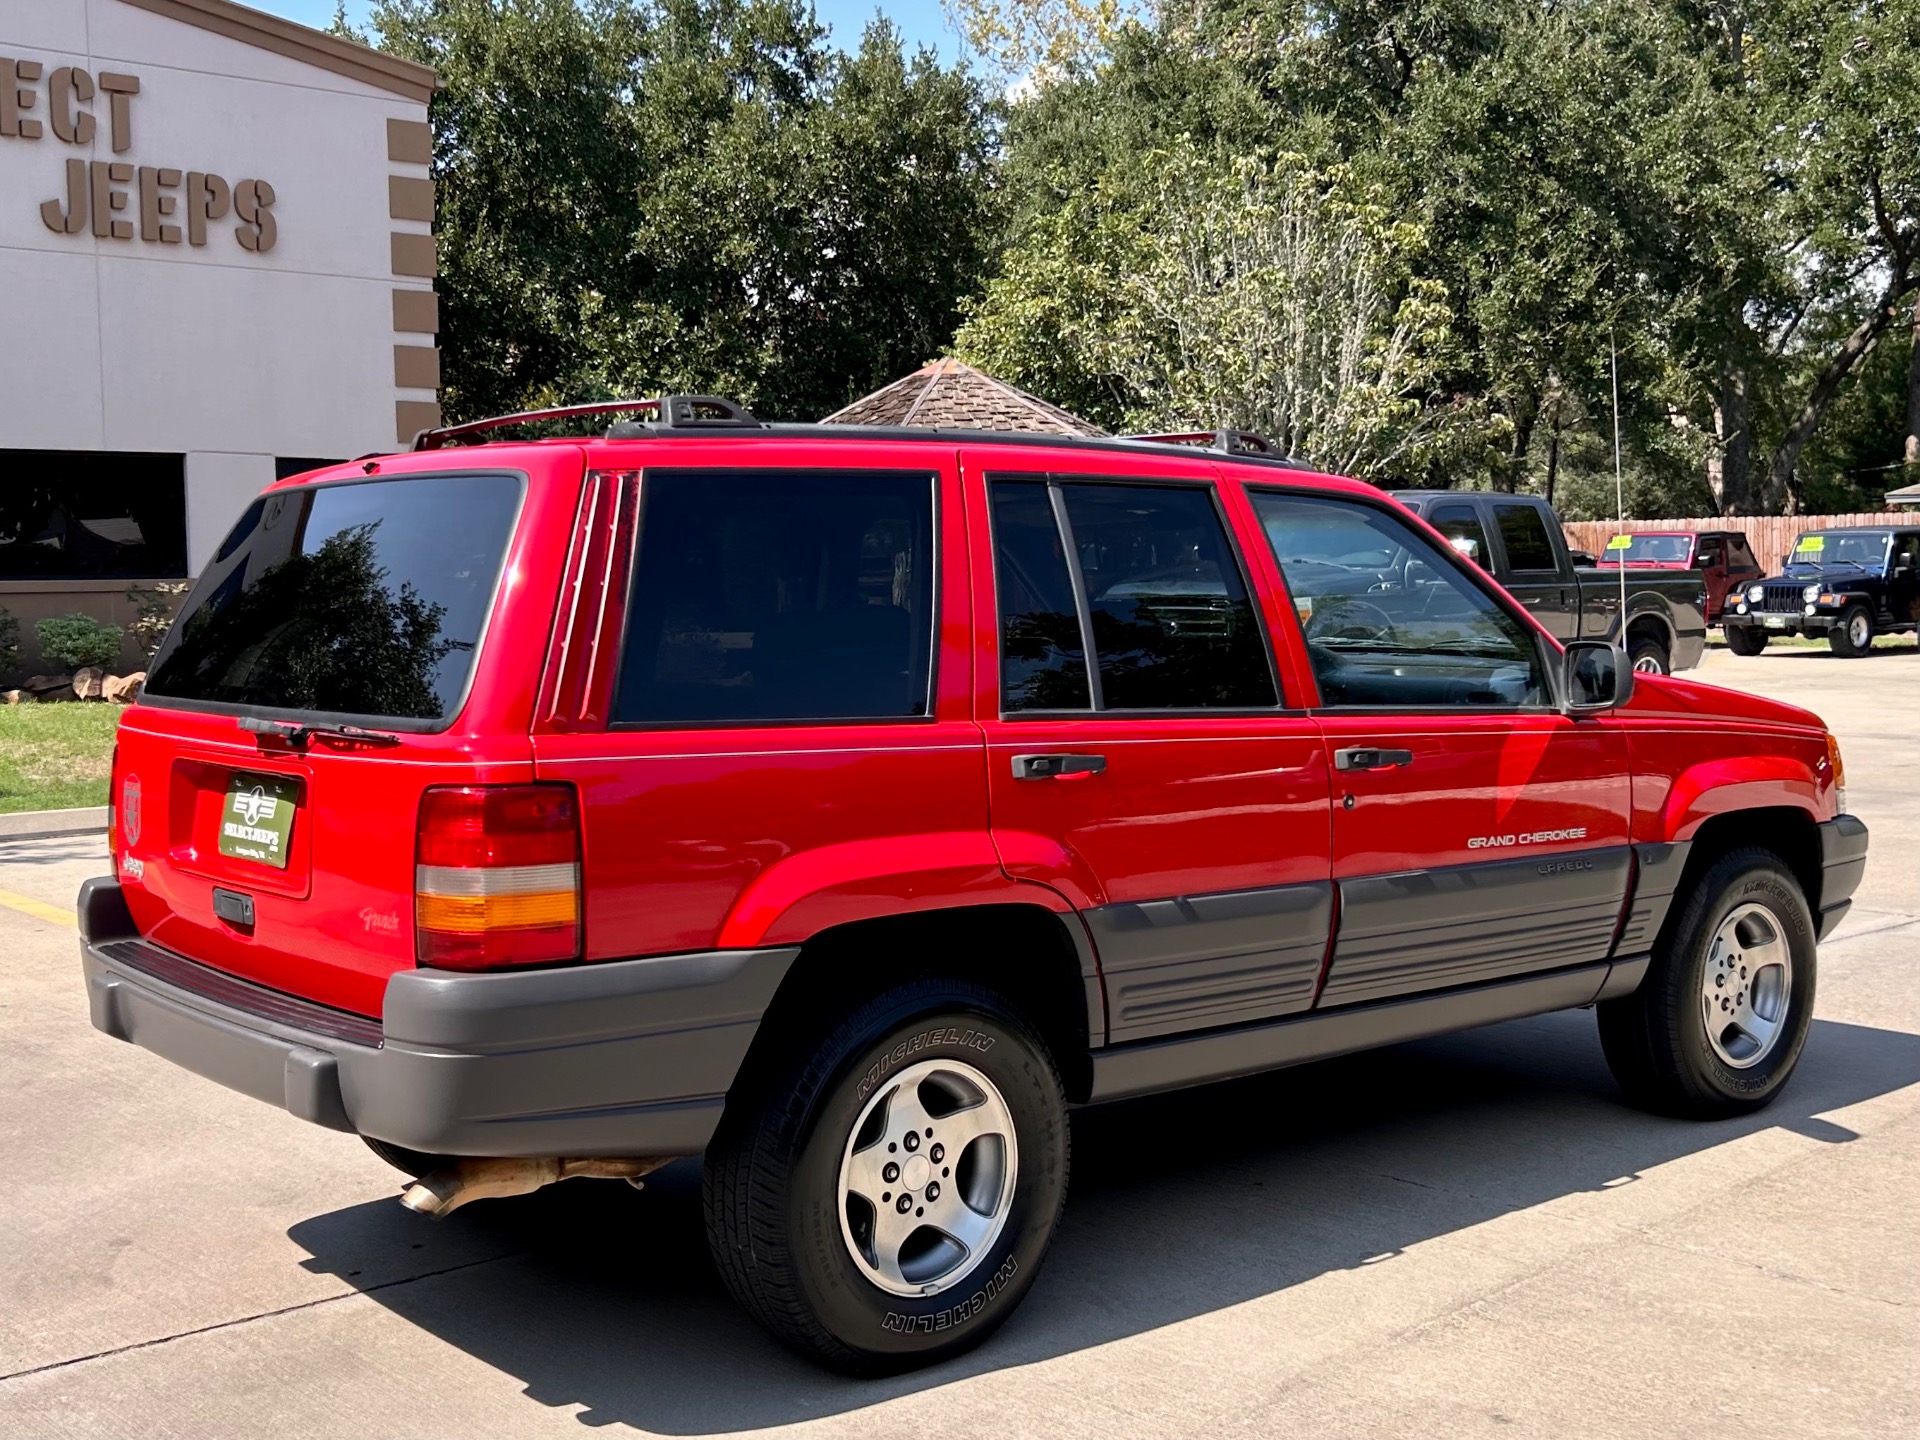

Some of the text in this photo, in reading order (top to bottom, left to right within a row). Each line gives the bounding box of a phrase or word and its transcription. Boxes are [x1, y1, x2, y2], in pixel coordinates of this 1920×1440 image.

[0, 57, 141, 153] ECT
[40, 158, 278, 252] JEEPS
[1467, 827, 1587, 849] GRAND CHEROKEE
[857, 1027, 995, 1100] MICHELIN
[882, 1254, 1019, 1334] MICHELIN
